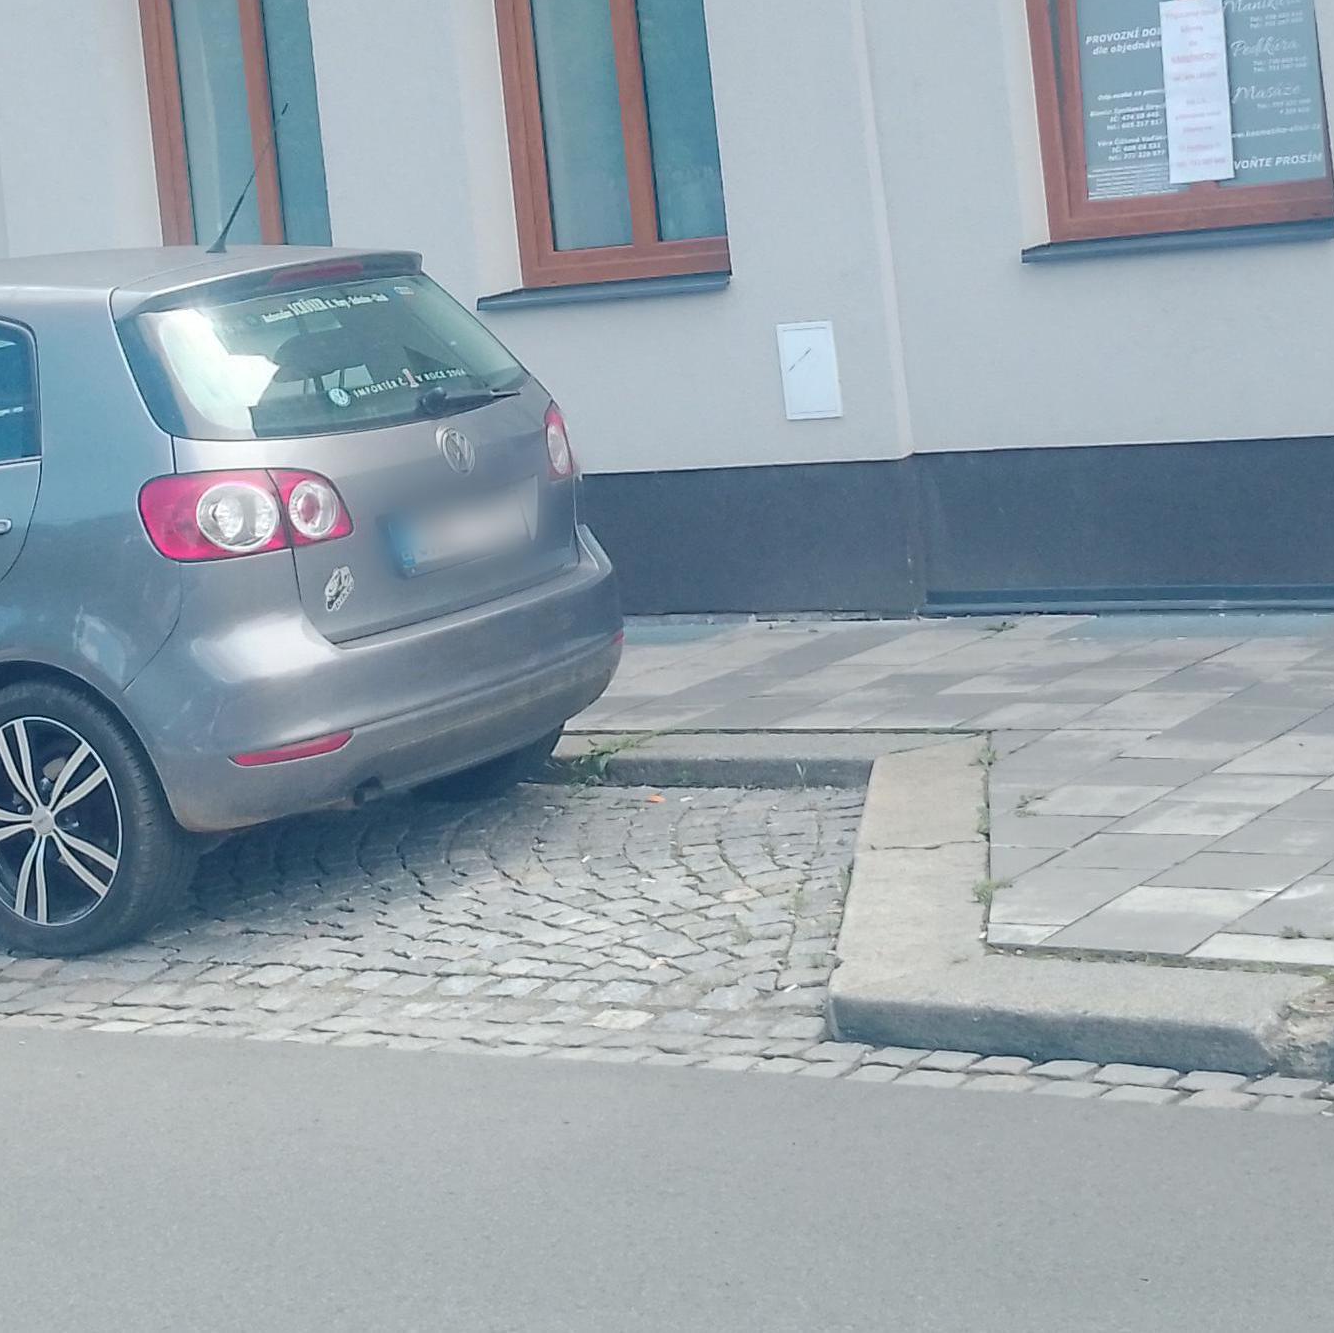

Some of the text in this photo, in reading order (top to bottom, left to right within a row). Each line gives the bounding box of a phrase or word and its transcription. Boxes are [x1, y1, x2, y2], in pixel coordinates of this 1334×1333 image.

[1085, 27, 1161, 44] PROVOZNÍ DO
[1092, 45, 1108, 56] dle
[1233, 156, 1272, 170] VOŇTE
